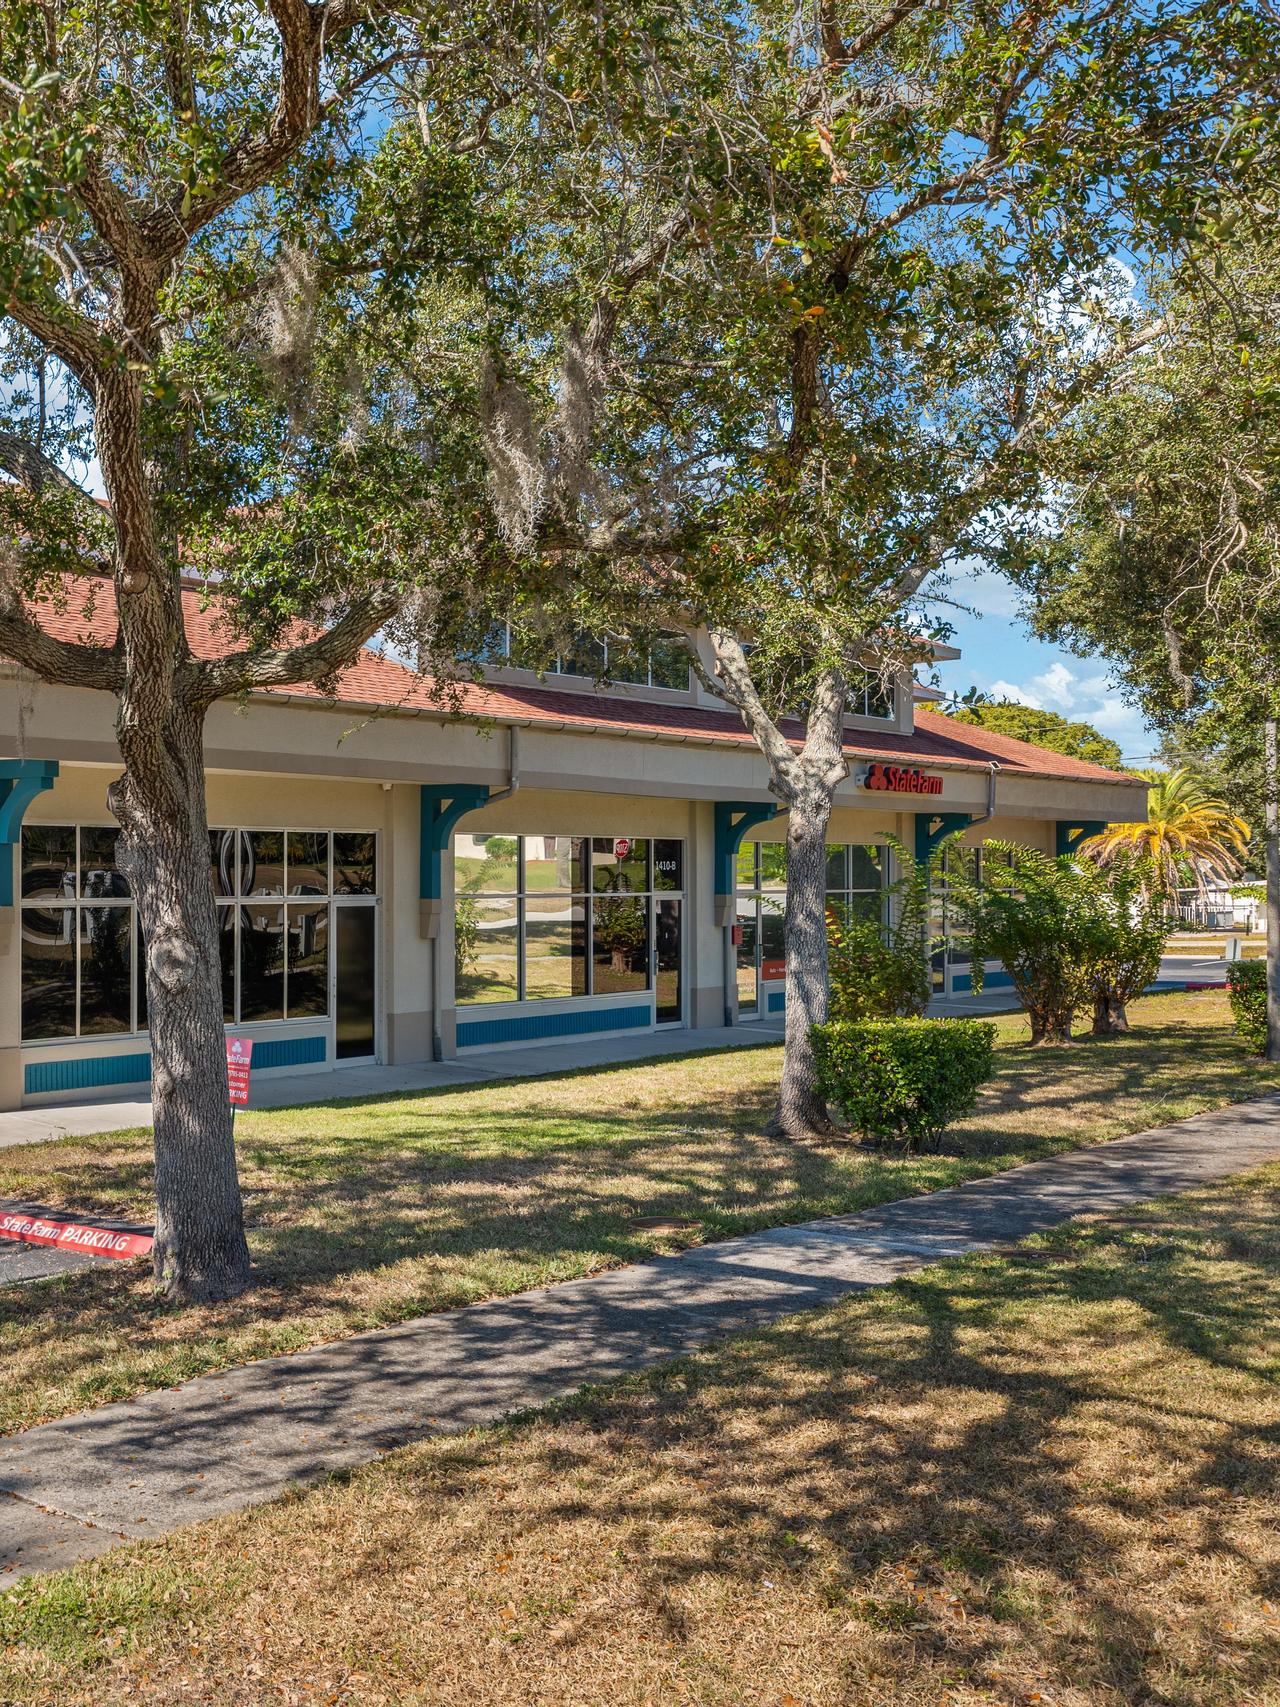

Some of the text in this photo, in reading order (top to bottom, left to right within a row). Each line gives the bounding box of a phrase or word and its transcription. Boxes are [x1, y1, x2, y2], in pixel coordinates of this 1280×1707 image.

[656, 861, 677, 871] 1410-B
[229, 1089, 247, 1099] RKING
[60, 1227, 130, 1250] PARKING
